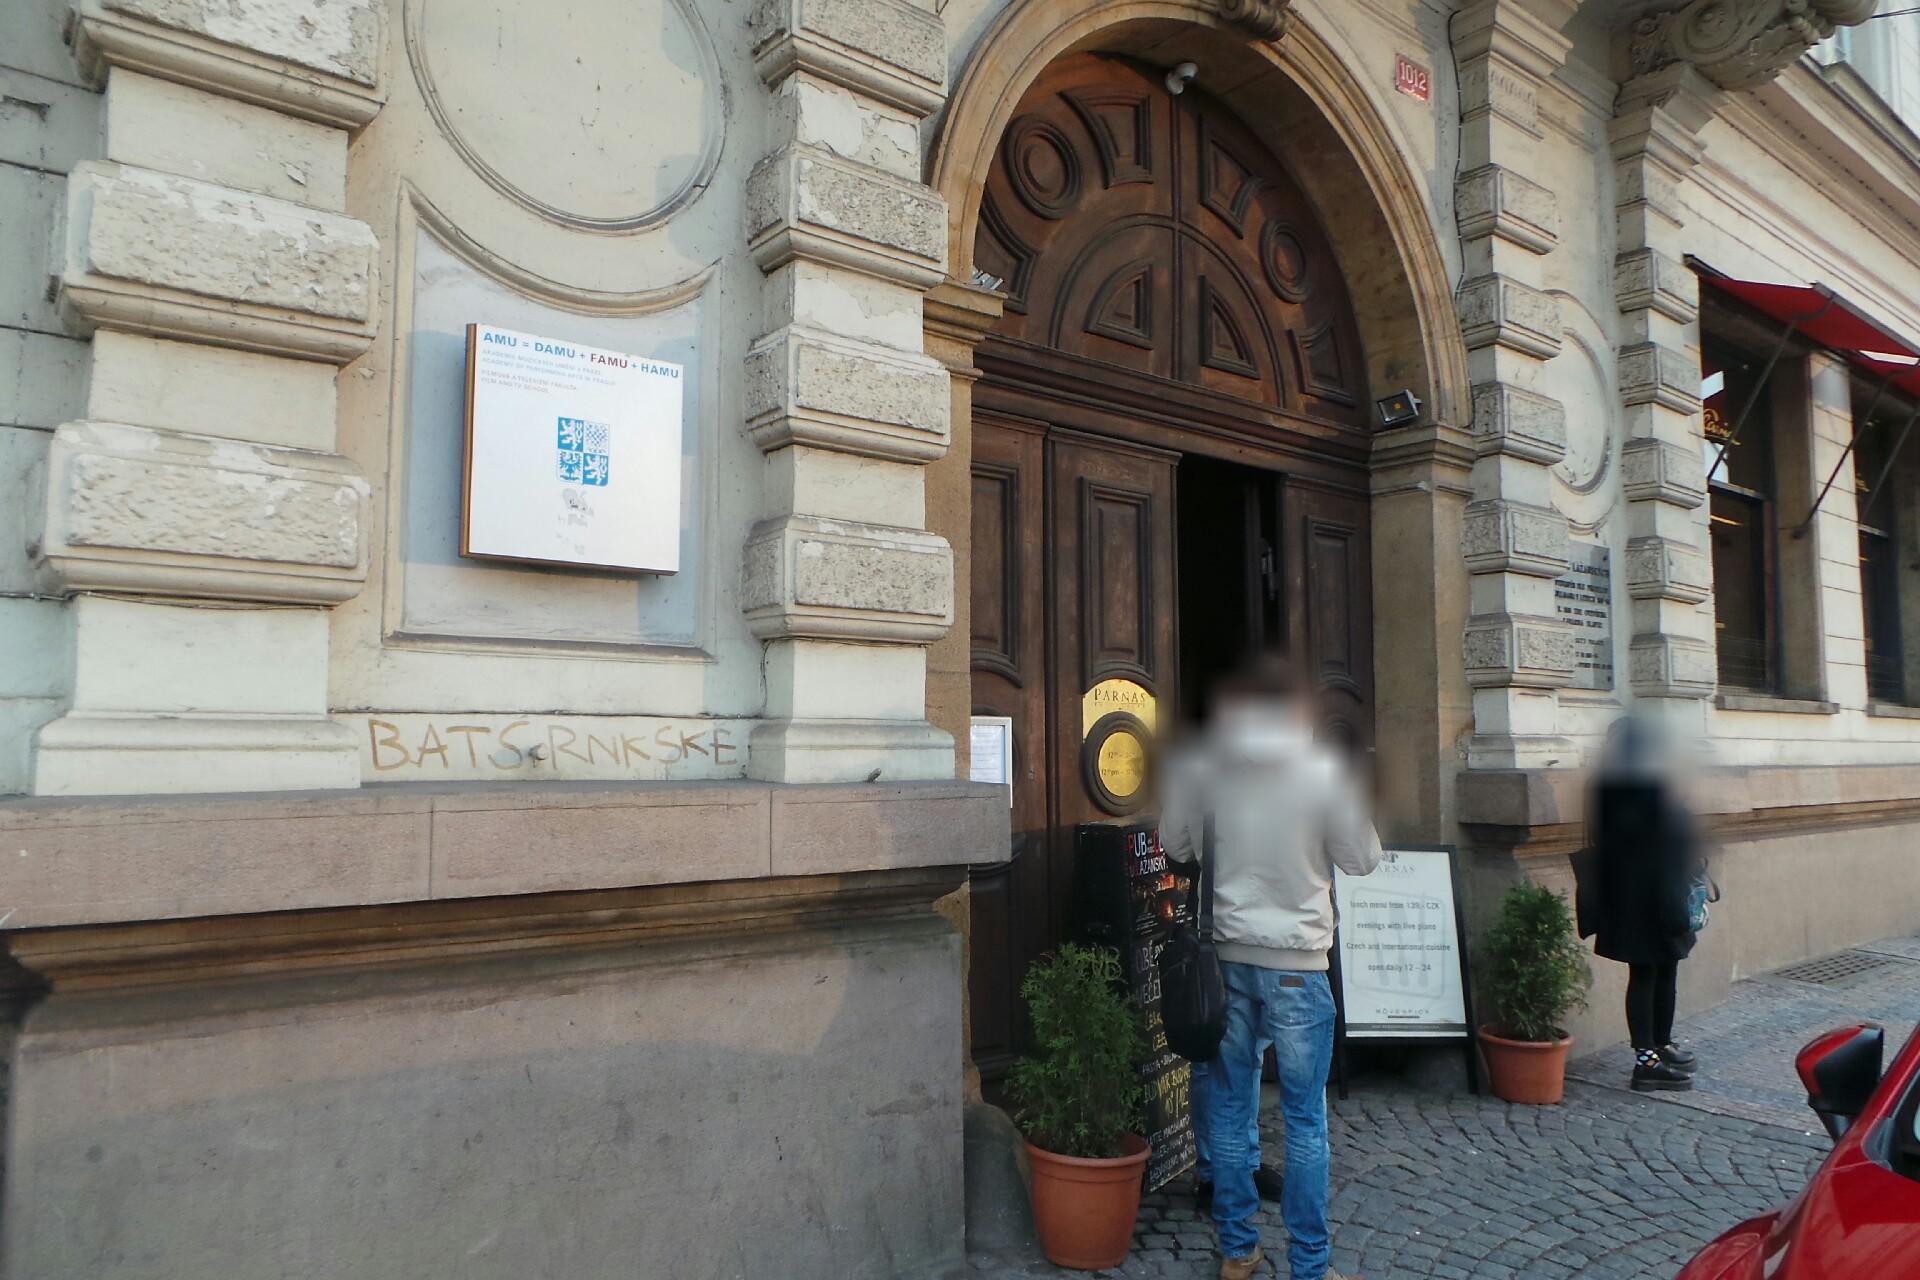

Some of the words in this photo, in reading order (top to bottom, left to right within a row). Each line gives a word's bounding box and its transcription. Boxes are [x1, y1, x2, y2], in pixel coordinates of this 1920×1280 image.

[1400, 62, 1427, 91] 1012
[483, 332, 517, 347] AMU
[534, 342, 575, 358] DAMU
[590, 353, 628, 369] FAMU
[641, 363, 679, 379] HAMU
[1095, 688, 1146, 702] PARNAS
[1128, 831, 1147, 857] PUB
[1379, 864, 1416, 873] ARNAS
[1426, 902, 1440, 910] CZK
[1387, 922, 1402, 930] with
[1403, 922, 1416, 930] live
[1346, 942, 1366, 950] Czech
[1404, 963, 1414, 971] 12
[1421, 964, 1431, 972] 24
